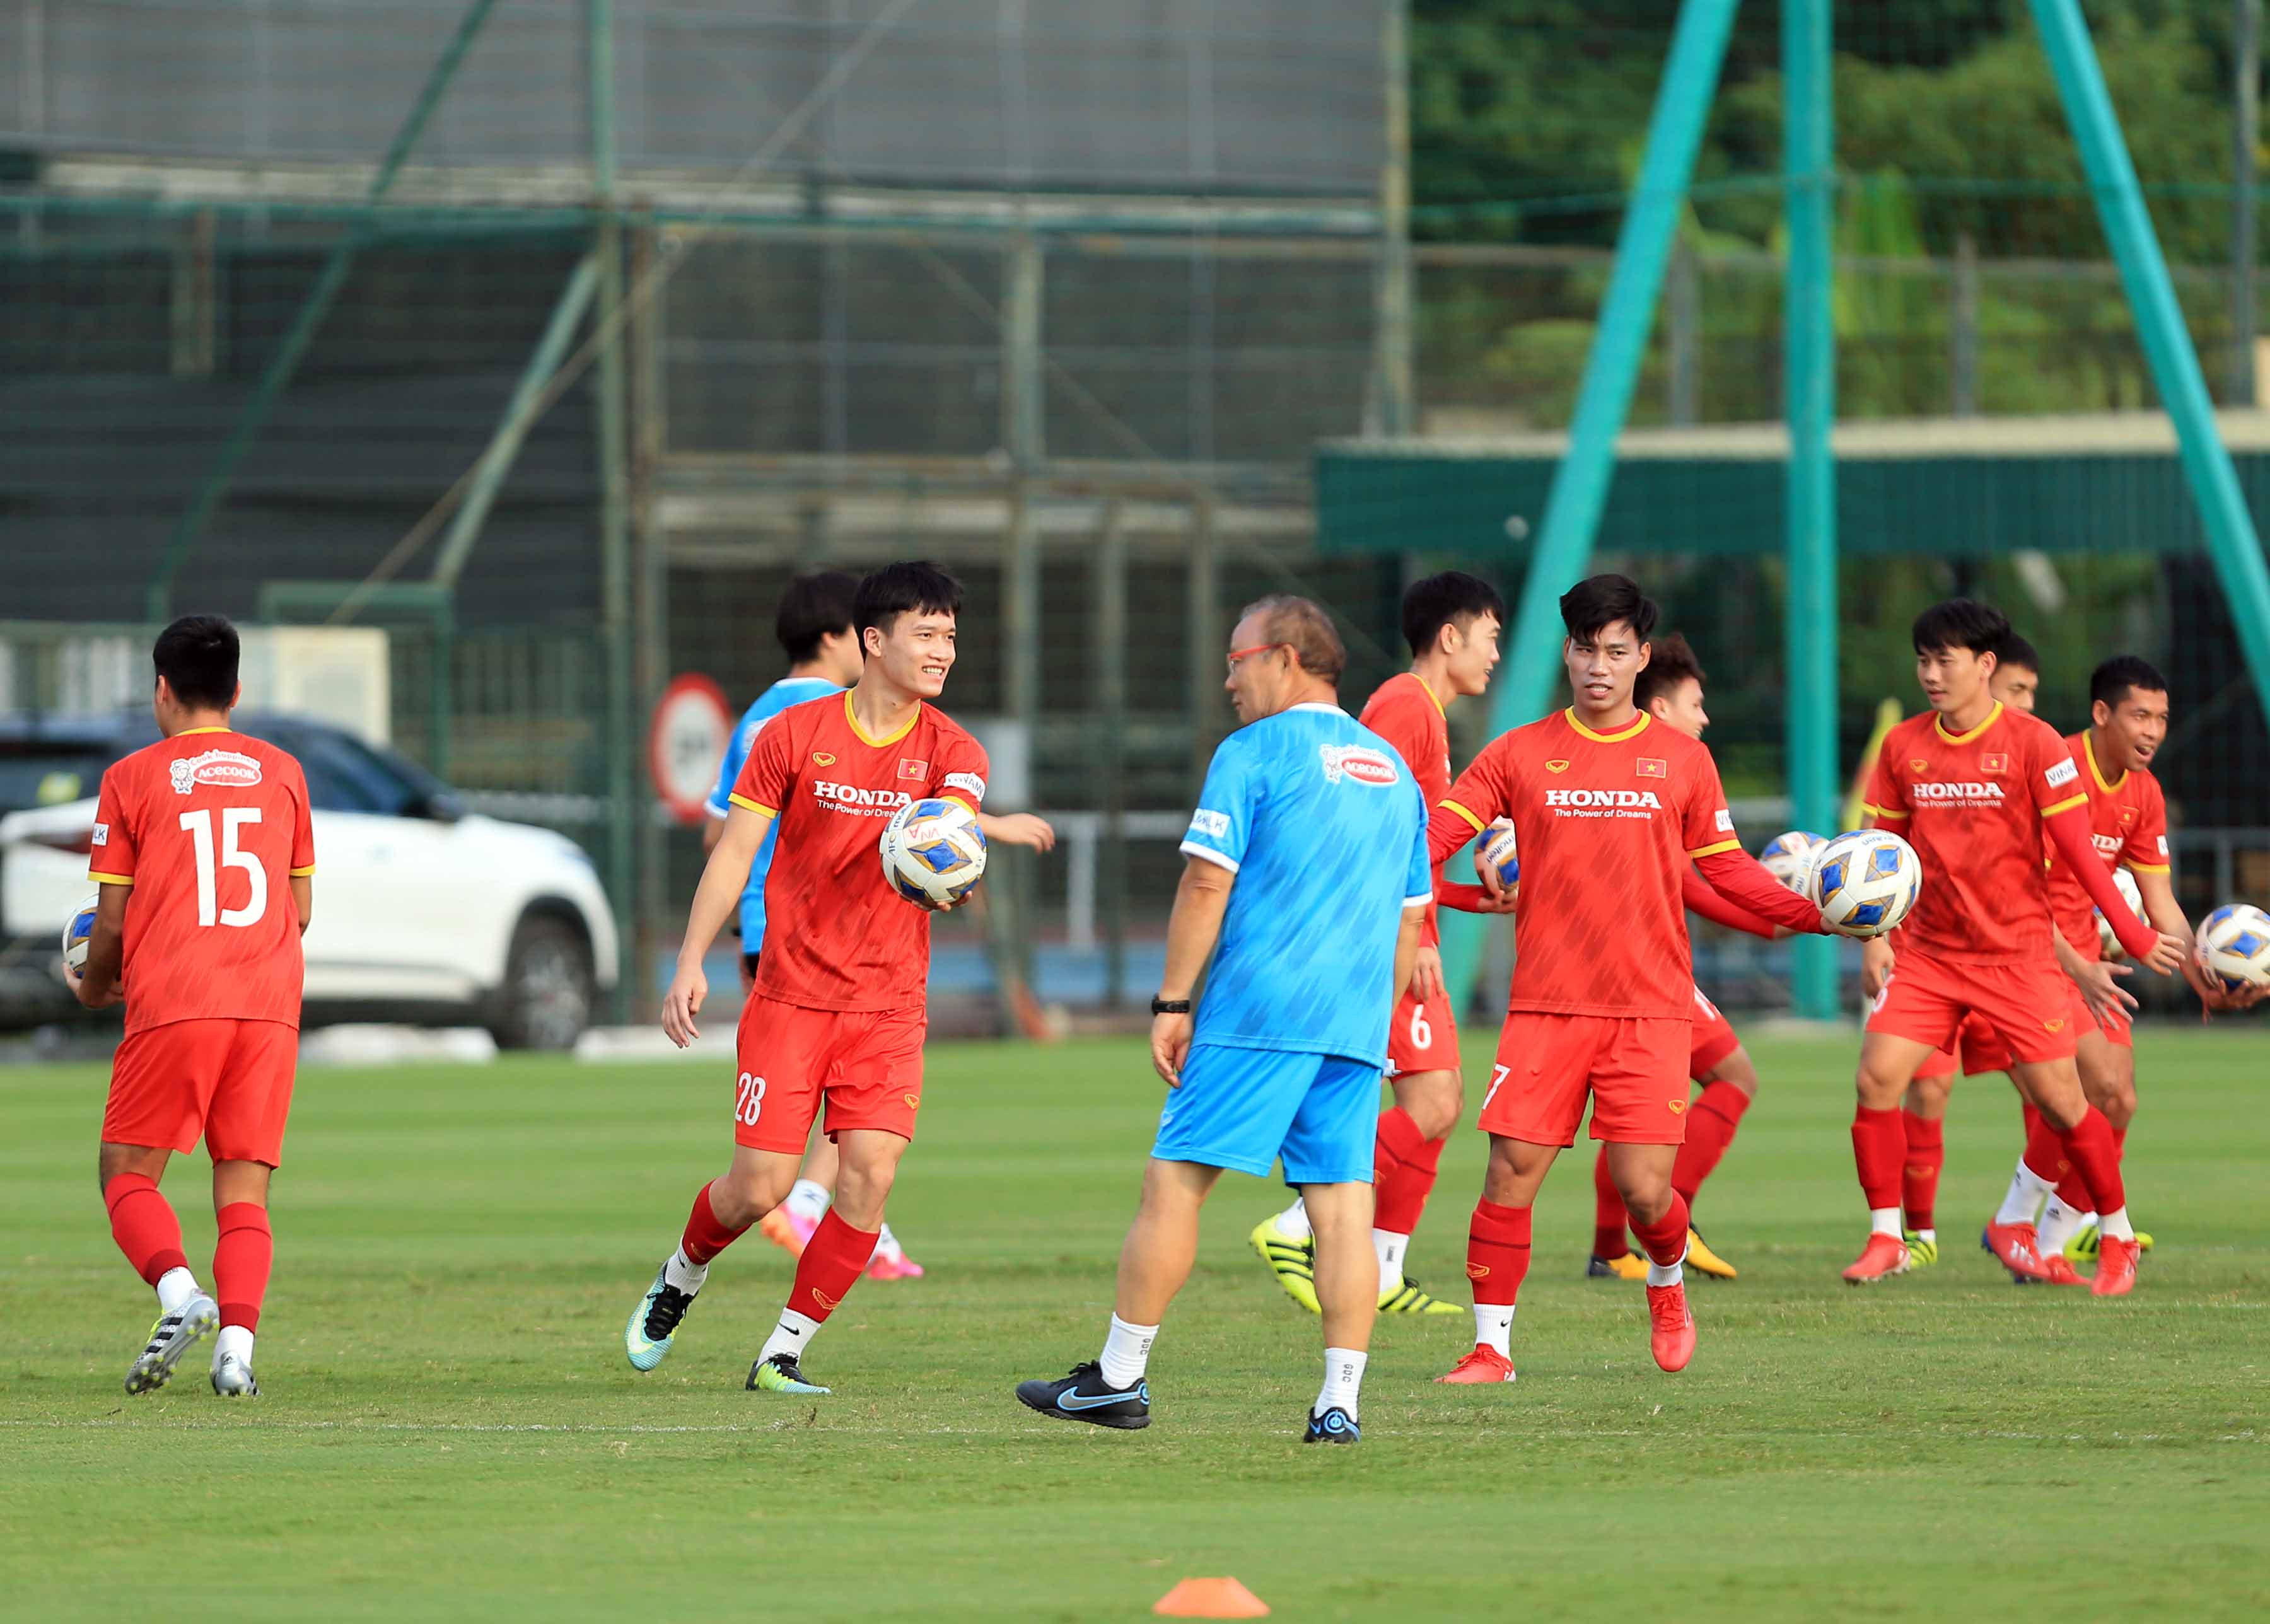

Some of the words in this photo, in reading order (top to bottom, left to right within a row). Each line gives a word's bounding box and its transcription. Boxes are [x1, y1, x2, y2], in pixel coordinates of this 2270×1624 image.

[813, 780, 913, 808] HONDA
[1545, 789, 1662, 809] HONDA
[1912, 782, 2006, 799] HONDA
[817, 799, 834, 809] The
[834, 803, 862, 815] Power
[864, 808, 874, 816] of
[875, 808, 895, 818] Drea
[1554, 808, 1571, 817] The
[1573, 809, 1602, 818] Power
[1616, 809, 1651, 819] Dreams
[1930, 799, 1955, 808] Power
[1967, 799, 2002, 808] Dreams
[179, 808, 268, 927] 15
[1410, 1004, 1433, 1050] 6
[735, 1072, 766, 1126] 28
